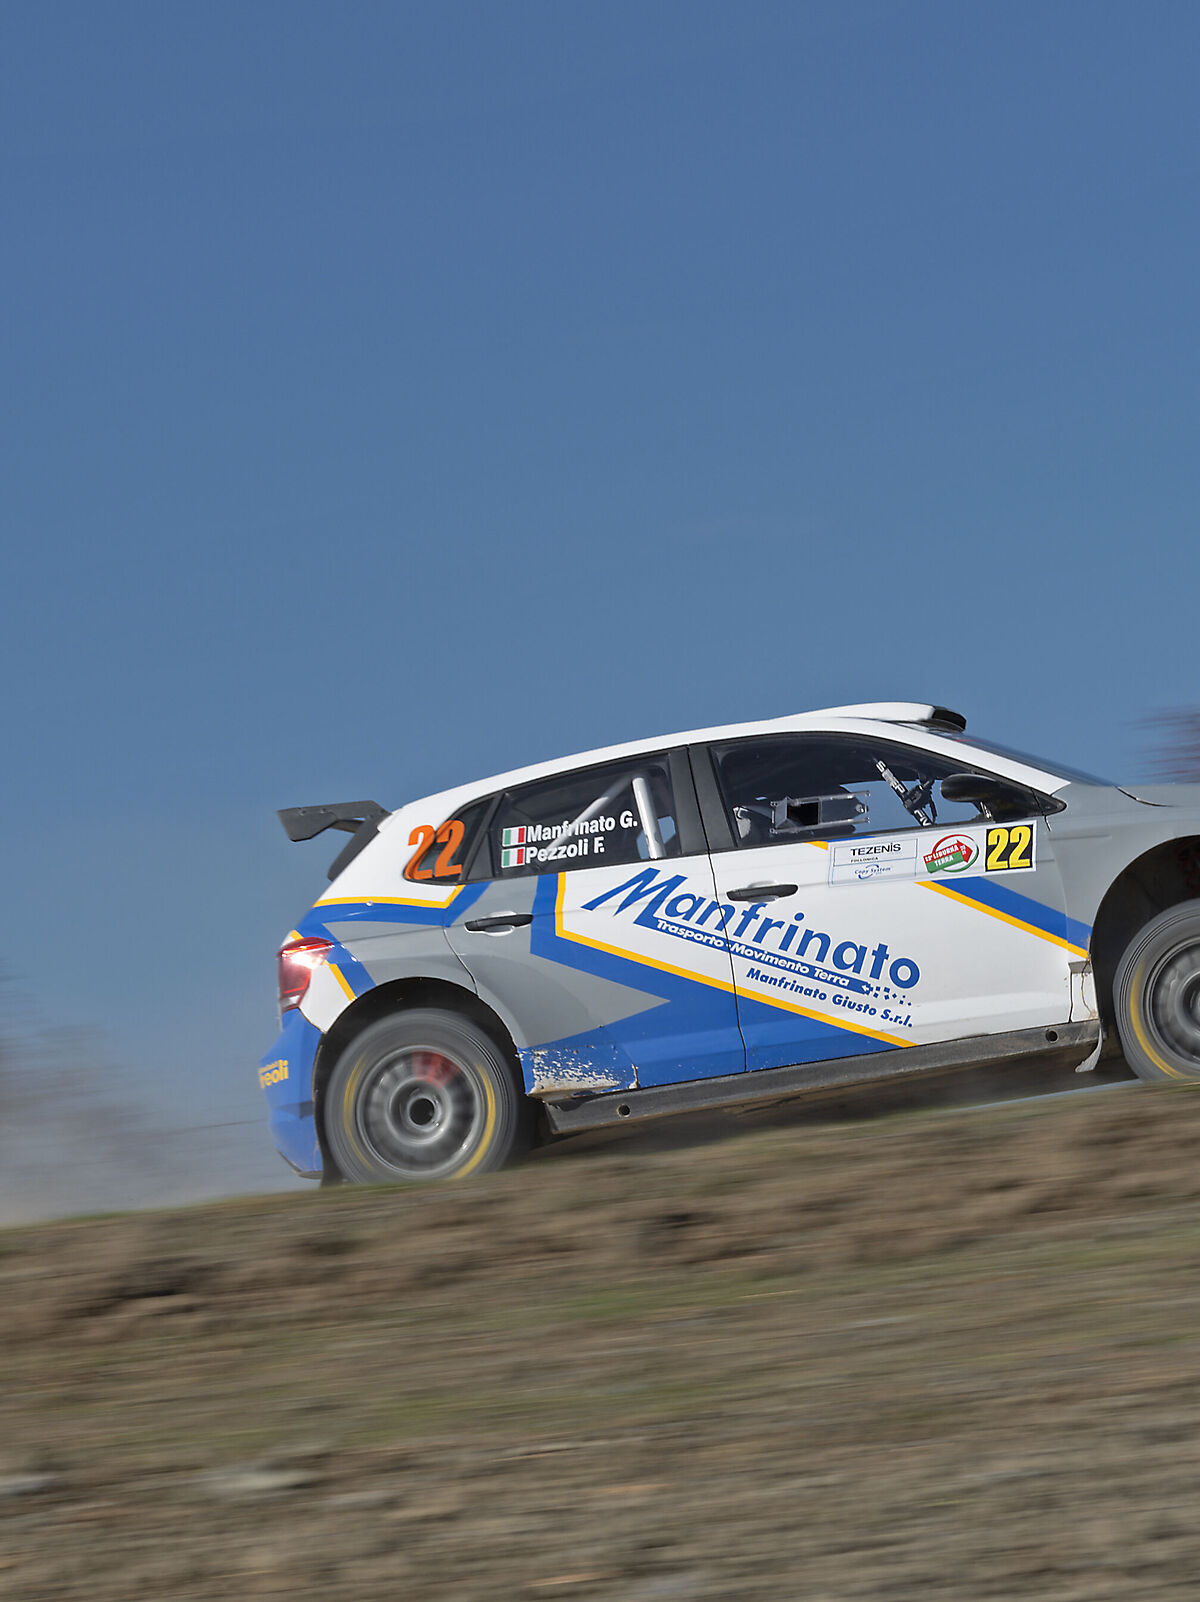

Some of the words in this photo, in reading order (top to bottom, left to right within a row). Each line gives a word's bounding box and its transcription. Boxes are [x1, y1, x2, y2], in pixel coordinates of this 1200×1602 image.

[527, 814, 616, 842] Manfrinato
[619, 810, 639, 829] G.
[986, 825, 1032, 871] 22
[404, 819, 466, 880] 22
[525, 838, 589, 864] Pezzoli
[593, 836, 606, 855] F.
[580, 867, 921, 990] Manfrinato
[745, 967, 828, 1002] Manfrinato
[831, 993, 878, 1017] Giusto
[880, 1007, 914, 1029] S.r.l.
[813, 966, 850, 987] Terra
